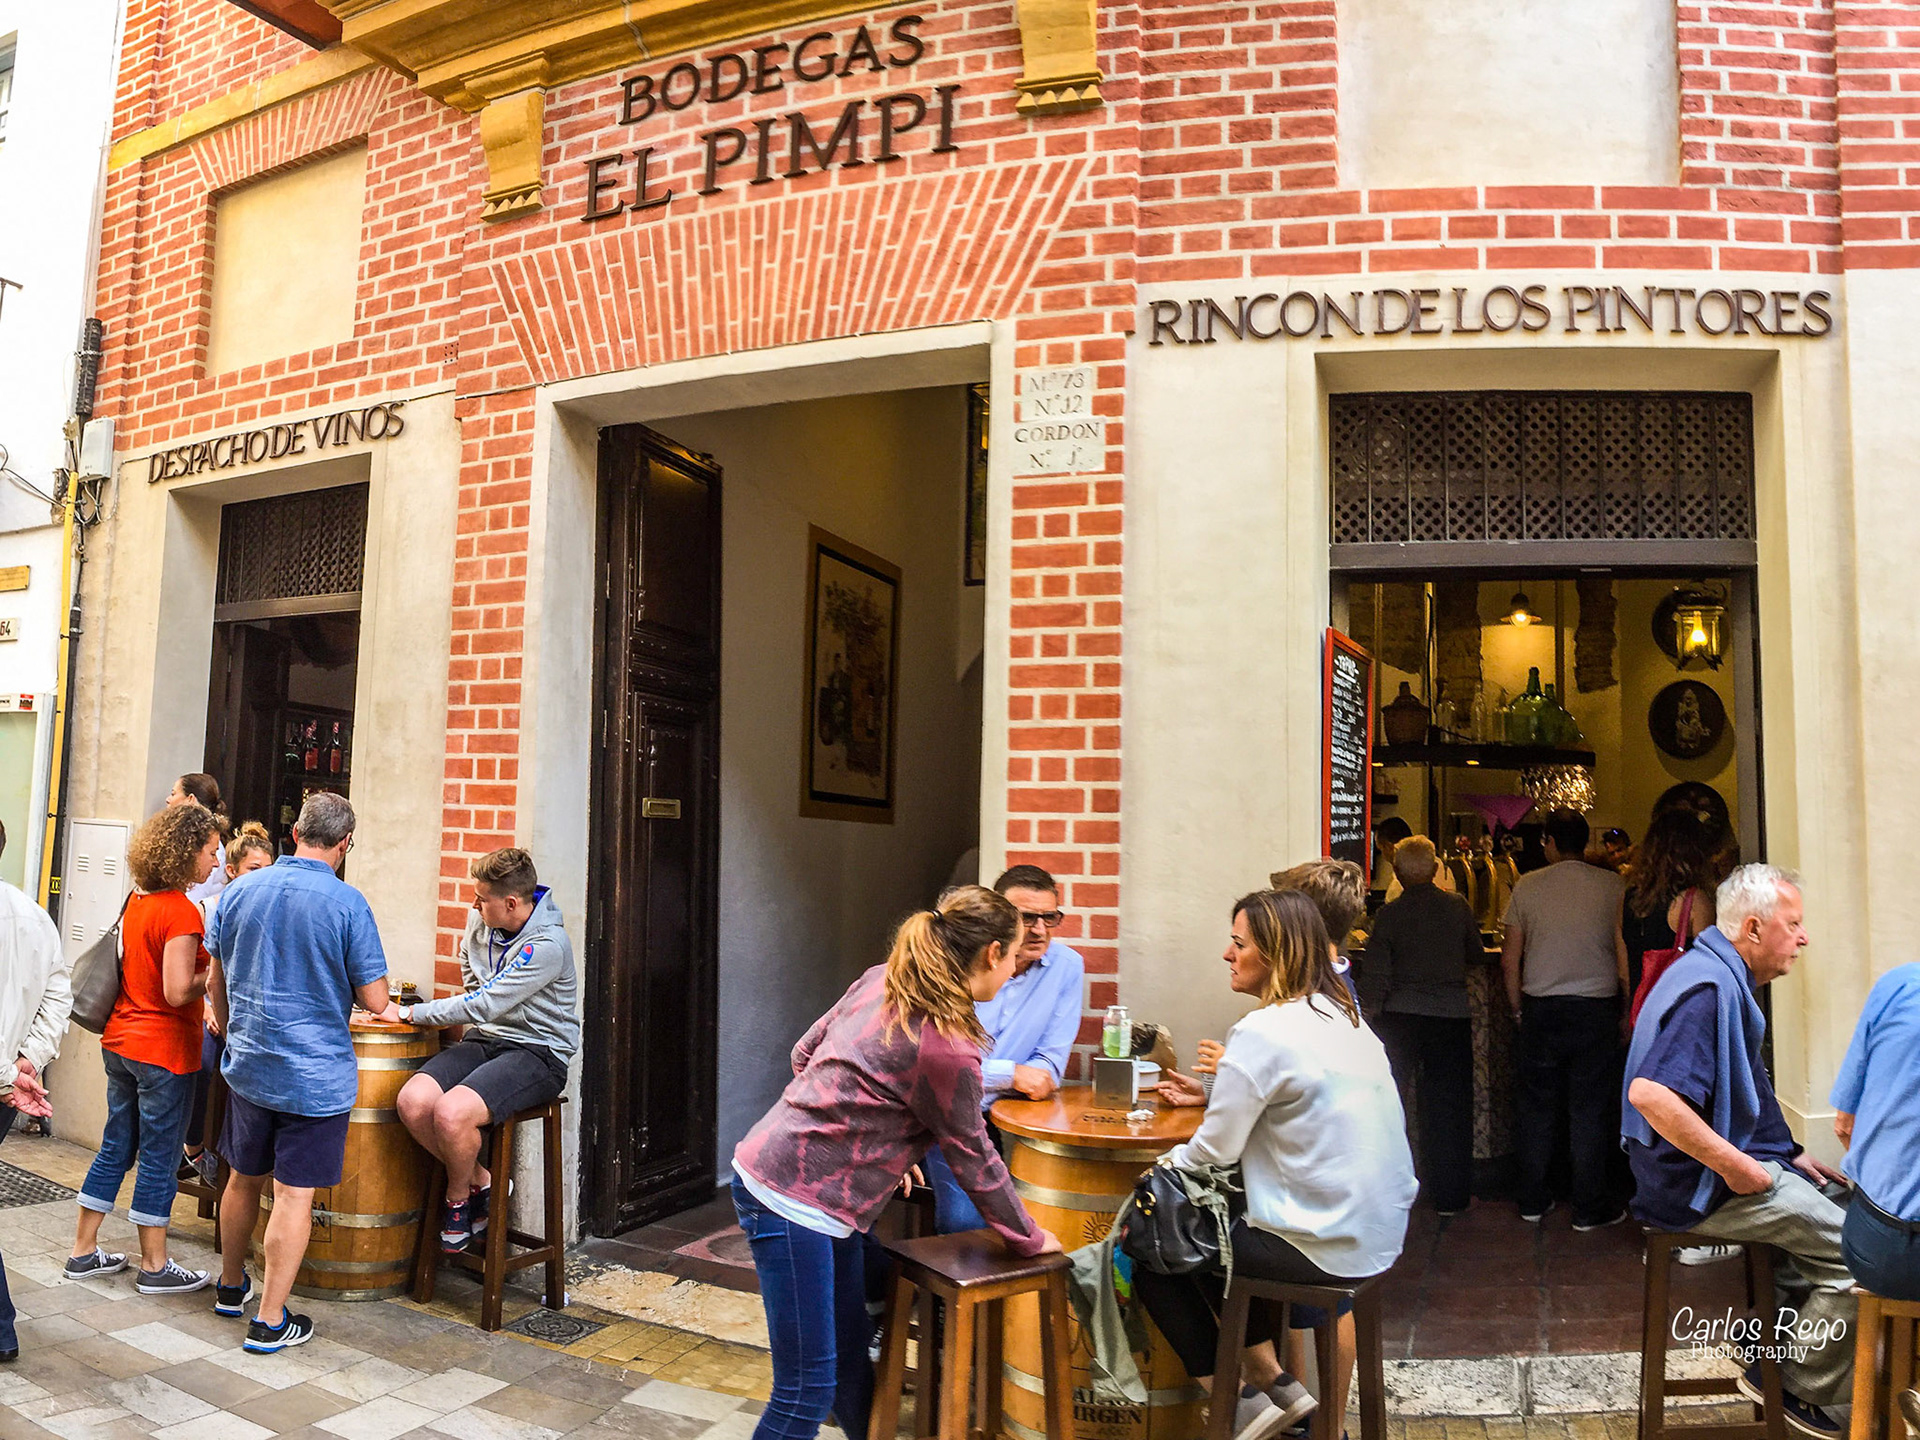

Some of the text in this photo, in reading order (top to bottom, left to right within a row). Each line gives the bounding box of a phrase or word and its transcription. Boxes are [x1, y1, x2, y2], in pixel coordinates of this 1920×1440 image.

[618, 15, 925, 126] BODEGAS
[580, 84, 962, 222] EL PIMPI
[1149, 284, 1833, 345] RINCON DE LOS PINTORES
[148, 402, 405, 485] DESPACHO DE VINOS
[1014, 422, 1101, 443] CORDON
[1073, 1405, 1143, 1425] IRGEN
